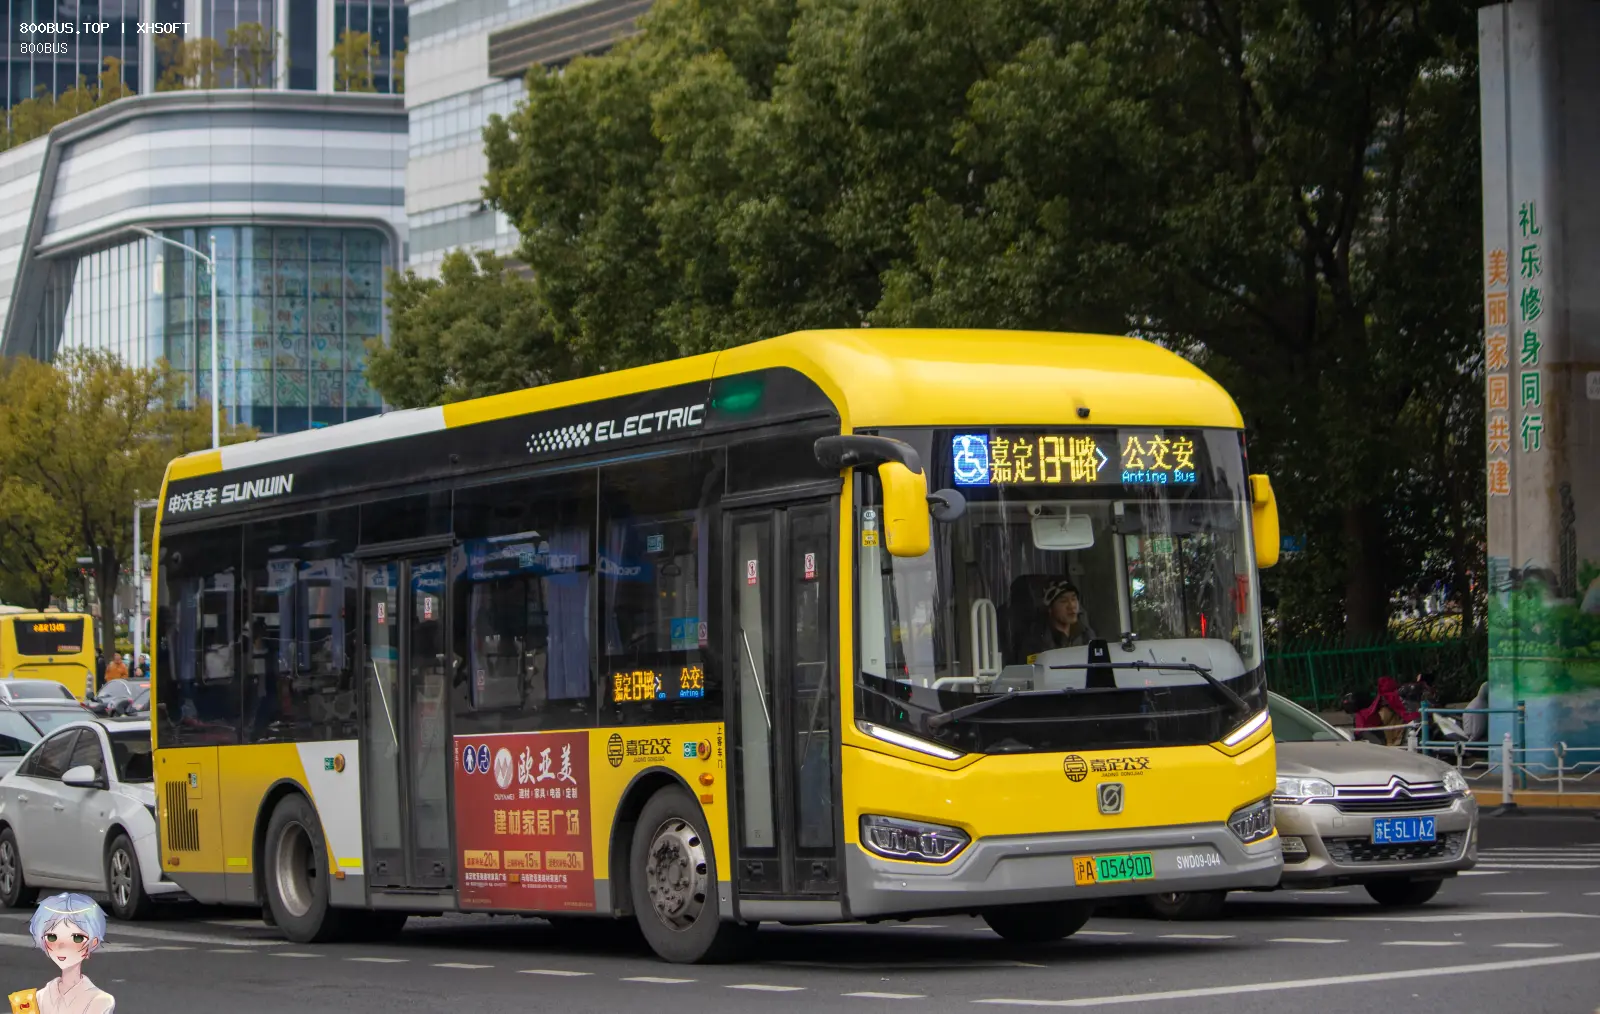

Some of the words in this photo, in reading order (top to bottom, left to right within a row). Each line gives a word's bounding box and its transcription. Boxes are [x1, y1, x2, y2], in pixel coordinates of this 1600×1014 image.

[1518, 201, 1543, 451] 礼乐修身同行
[1487, 249, 1510, 496] 美丽家园共建
[594, 403, 705, 442] ELECTRIC
[989, 436, 1098, 483] 嘉定134路
[221, 473, 294, 504] SUNWIN
[1122, 471, 1167, 483] Anting
[1174, 471, 1195, 482] Bus
[168, 487, 219, 514] 申沃客车
[680, 666, 704, 689] 公交
[626, 738, 672, 756] 嘉定公交
[518, 743, 577, 785] 欧亚美
[1090, 756, 1151, 772] 嘉定公交
[494, 793, 515, 801] OUYAMEI
[494, 809, 579, 835] 建材家居广场
[1176, 853, 1221, 869] SWD09-044
